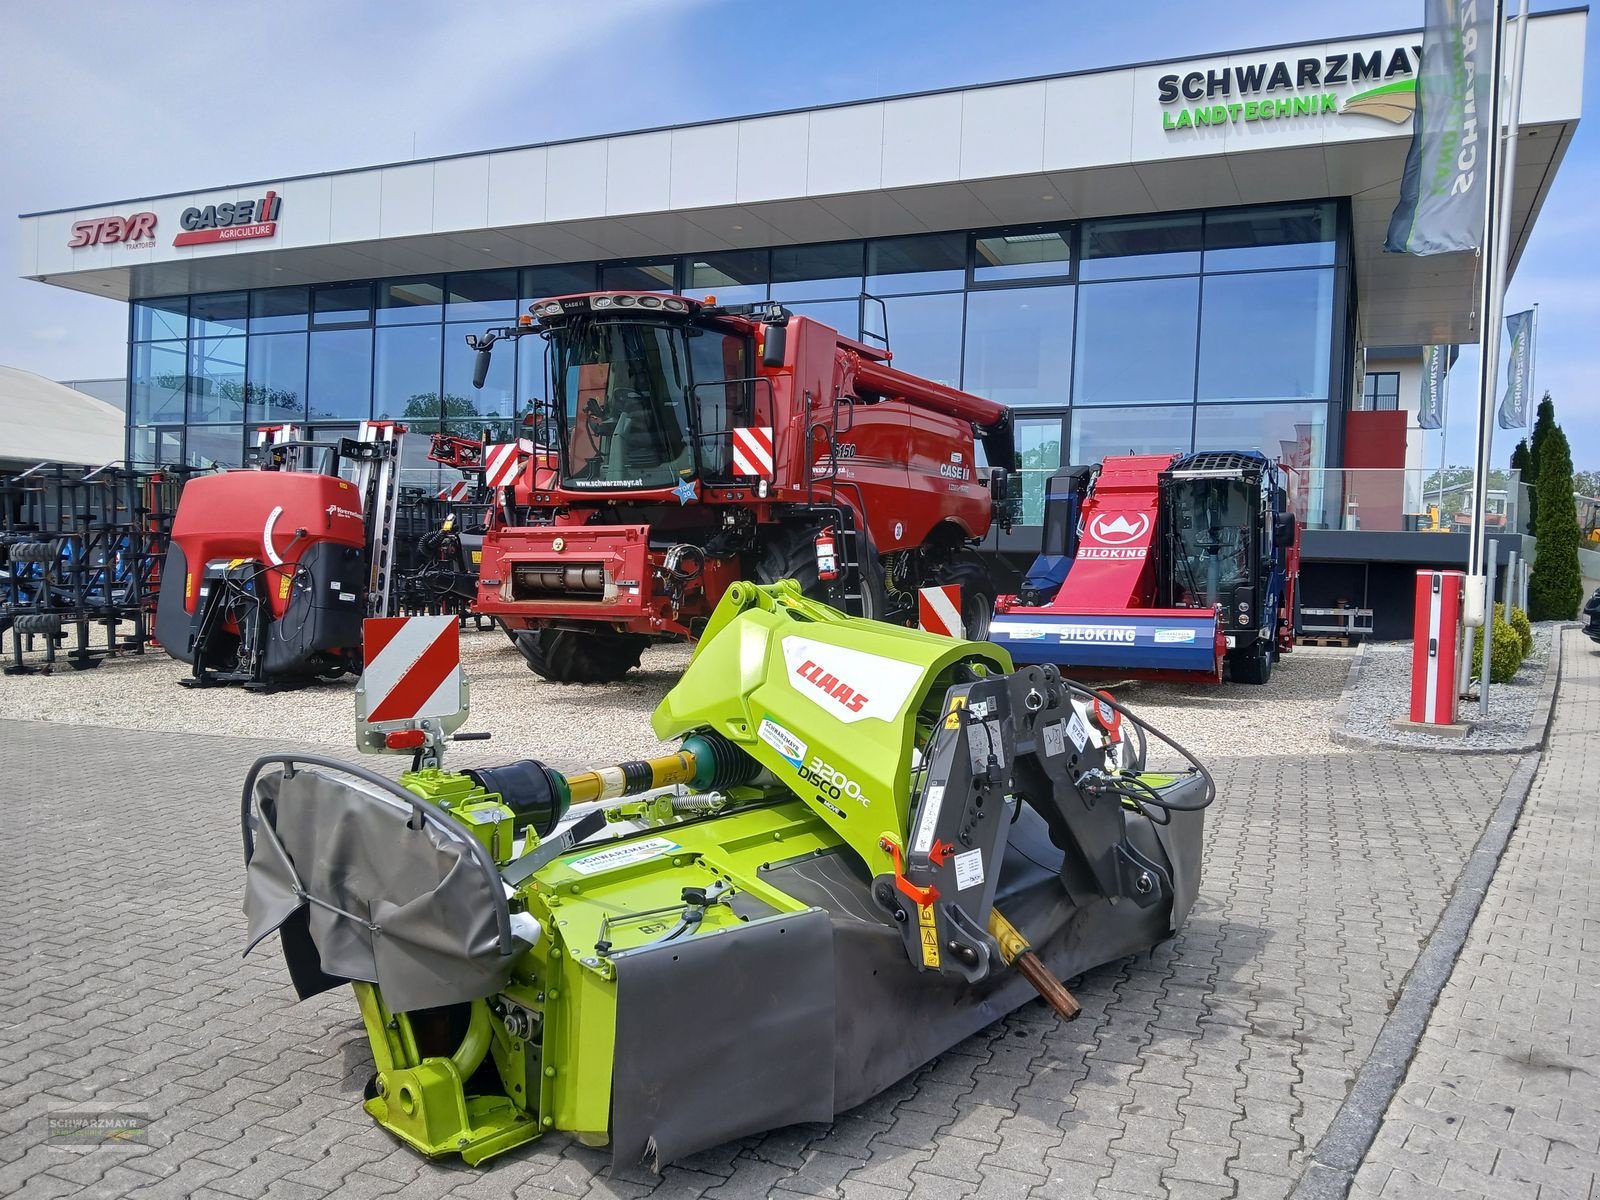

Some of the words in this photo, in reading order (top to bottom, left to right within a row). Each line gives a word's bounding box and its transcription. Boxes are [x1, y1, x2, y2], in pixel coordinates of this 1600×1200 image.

[1163, 93, 1338, 130] LANDTECHNIK
[68, 212, 158, 248] STEYR
[219, 225, 270, 239] AGRICULTURE
[576, 478, 643, 488] www.schwarzmayr.at
[679, 484, 691, 493] TOP
[683, 490, 692, 498] 20
[1077, 549, 1148, 558] SILOKING
[1060, 628, 1136, 642] SILOKING
[797, 660, 869, 713] CLAAS
[798, 765, 841, 800] DISCO
